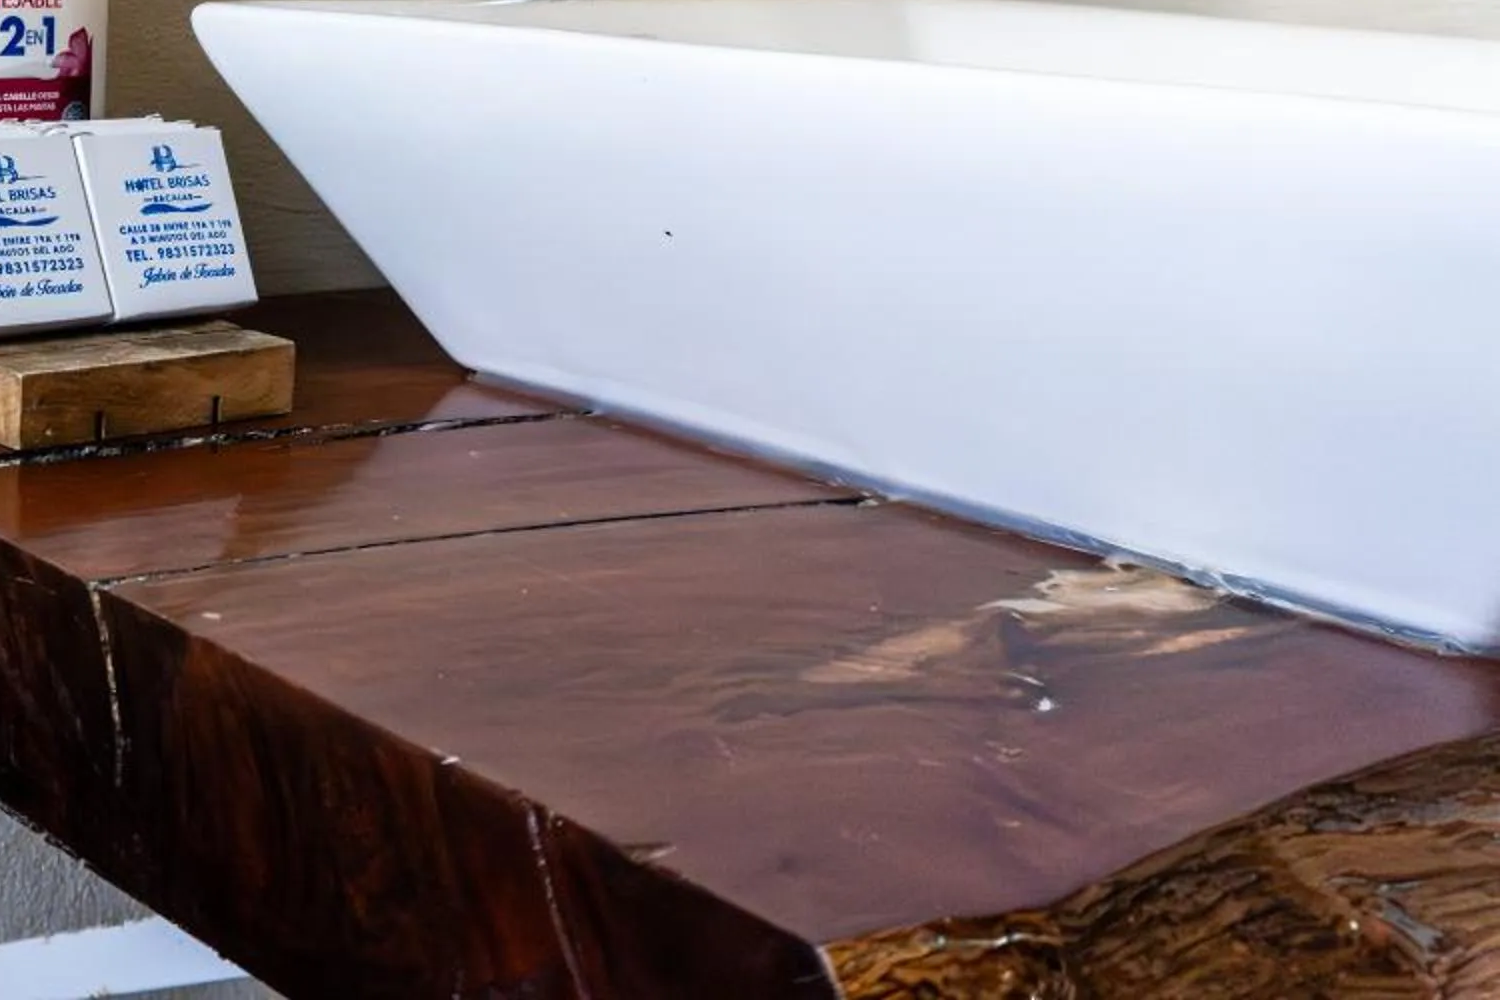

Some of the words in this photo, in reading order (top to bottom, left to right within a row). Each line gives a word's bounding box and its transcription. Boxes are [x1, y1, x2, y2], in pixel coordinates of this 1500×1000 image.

[167, 174, 211, 189] BRISAS
[8, 186, 56, 202] BRISAS
[119, 223, 148, 235] CALLE
[130, 235, 139, 245] A
[33, 246, 51, 255] DEL
[53, 243, 76, 255] ADO
[126, 248, 153, 262] TEL.
[157, 243, 235, 260] 9831572323
[20, 281, 34, 297] de
